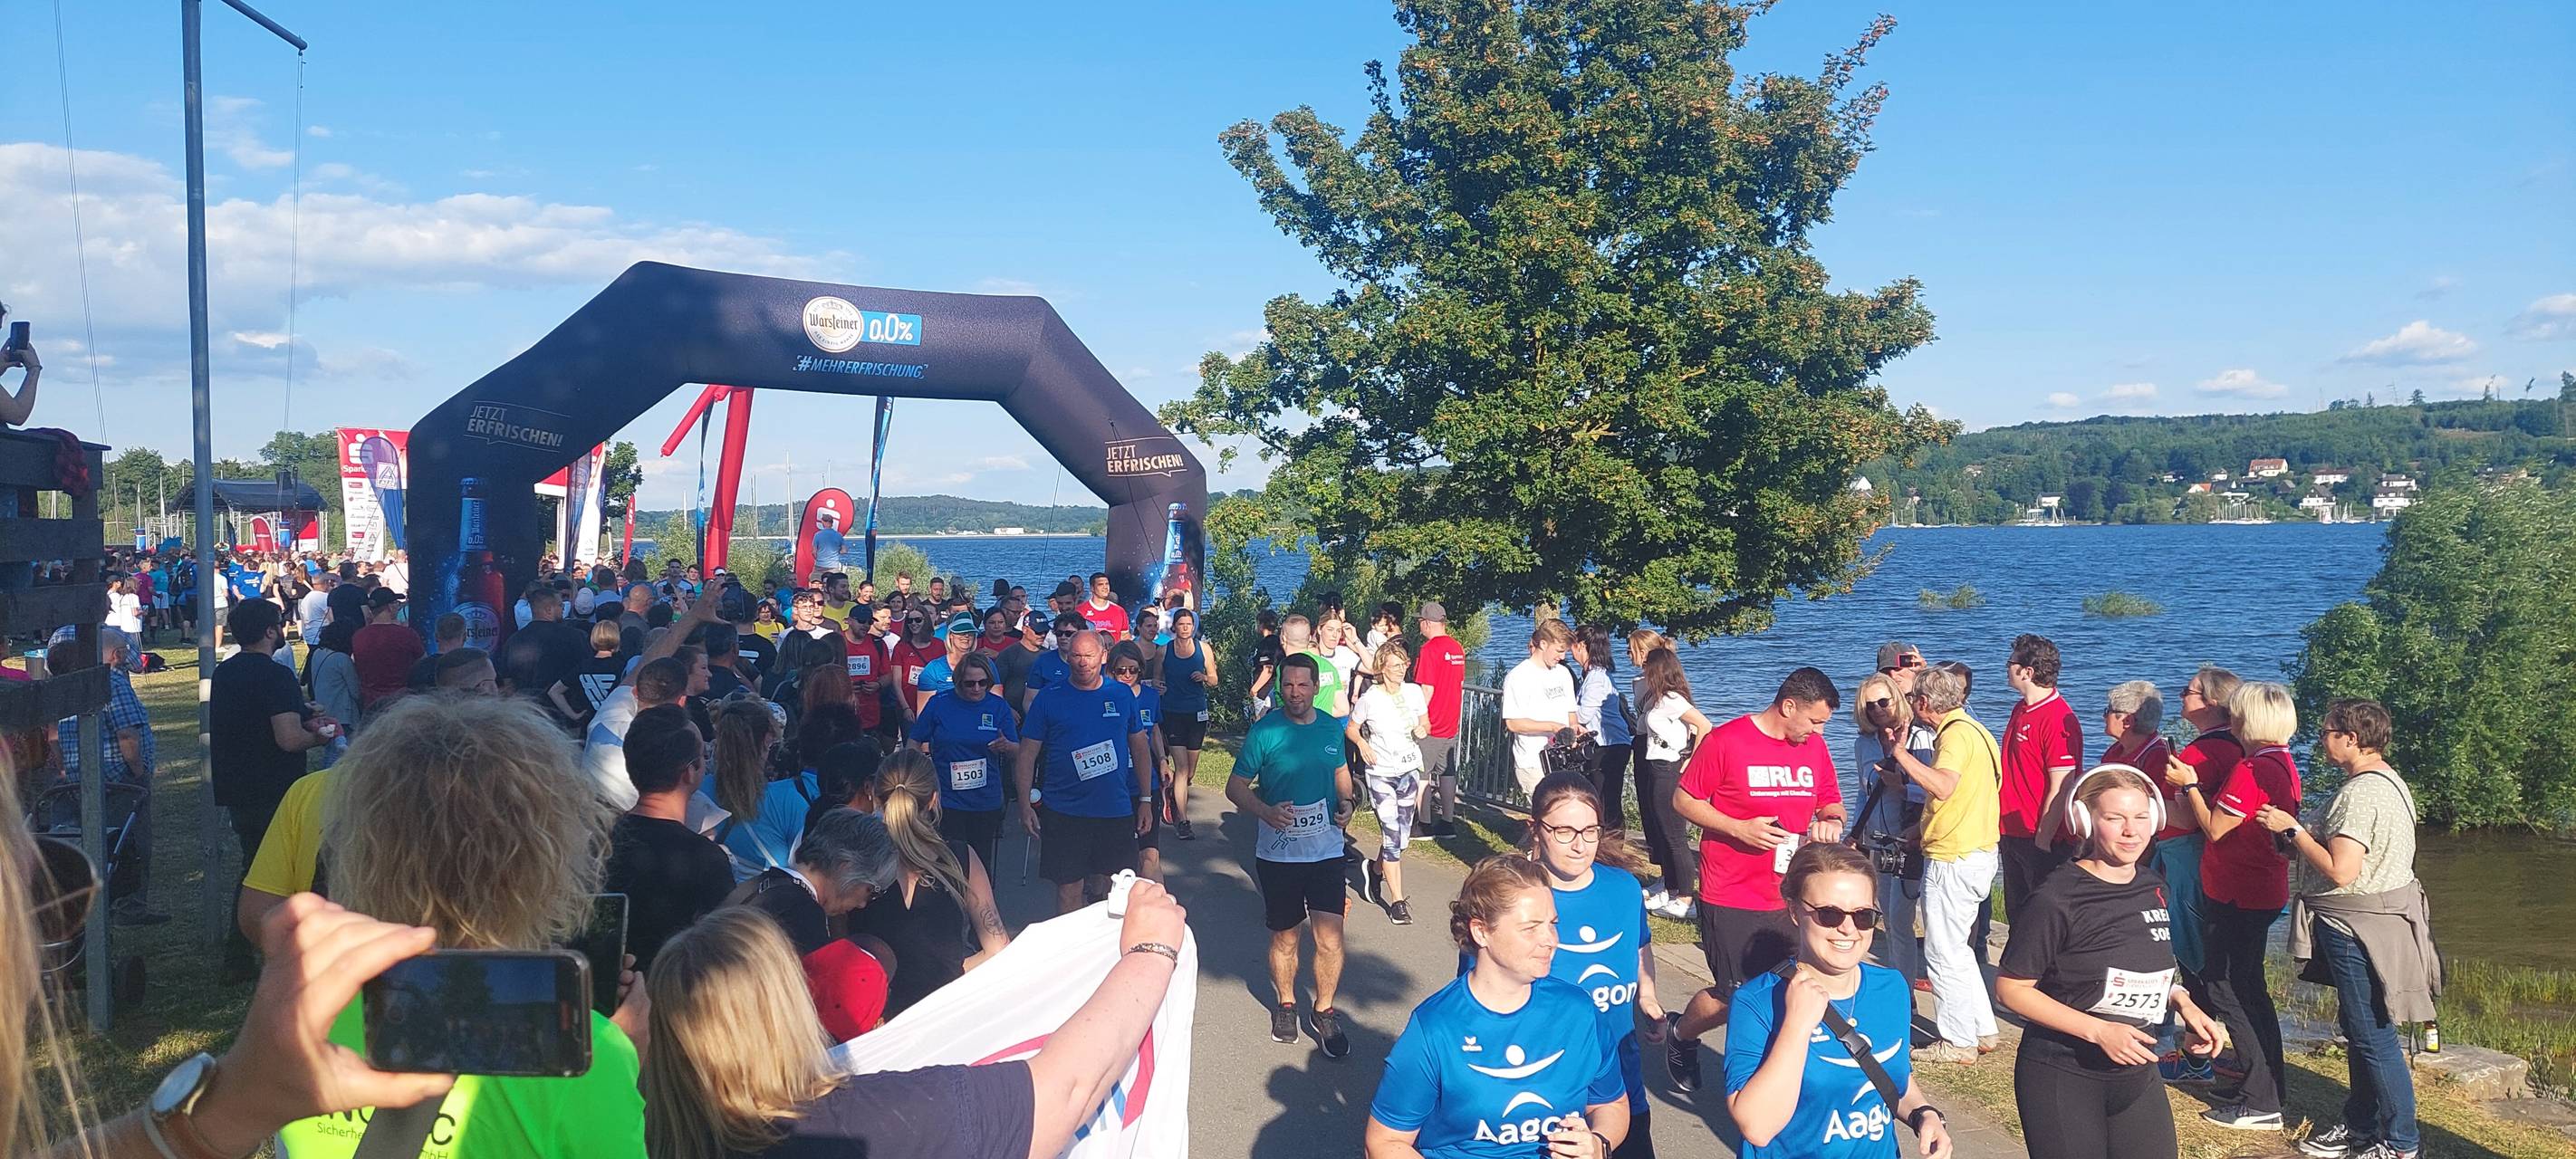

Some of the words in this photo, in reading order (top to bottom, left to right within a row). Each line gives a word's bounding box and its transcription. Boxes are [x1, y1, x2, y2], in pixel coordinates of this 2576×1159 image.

[809, 312, 859, 330] Warsteiner
[869, 313, 913, 341] 0,0%
[796, 356, 925, 378] #MEHRERFRISCHUNG
[470, 405, 508, 422] JETZT
[466, 418, 563, 447] ERFRISCHEN!
[1106, 445, 1136, 460] JETZT
[1107, 454, 1184, 473] ERFRISCHEN!
[1081, 752, 1111, 770] 1508
[956, 769, 984, 781] 1503
[1768, 766, 1814, 788] RLG
[1293, 813, 1323, 828] 1929
[1592, 982, 1638, 1013] gon
[2110, 992, 2162, 1010] 2573
